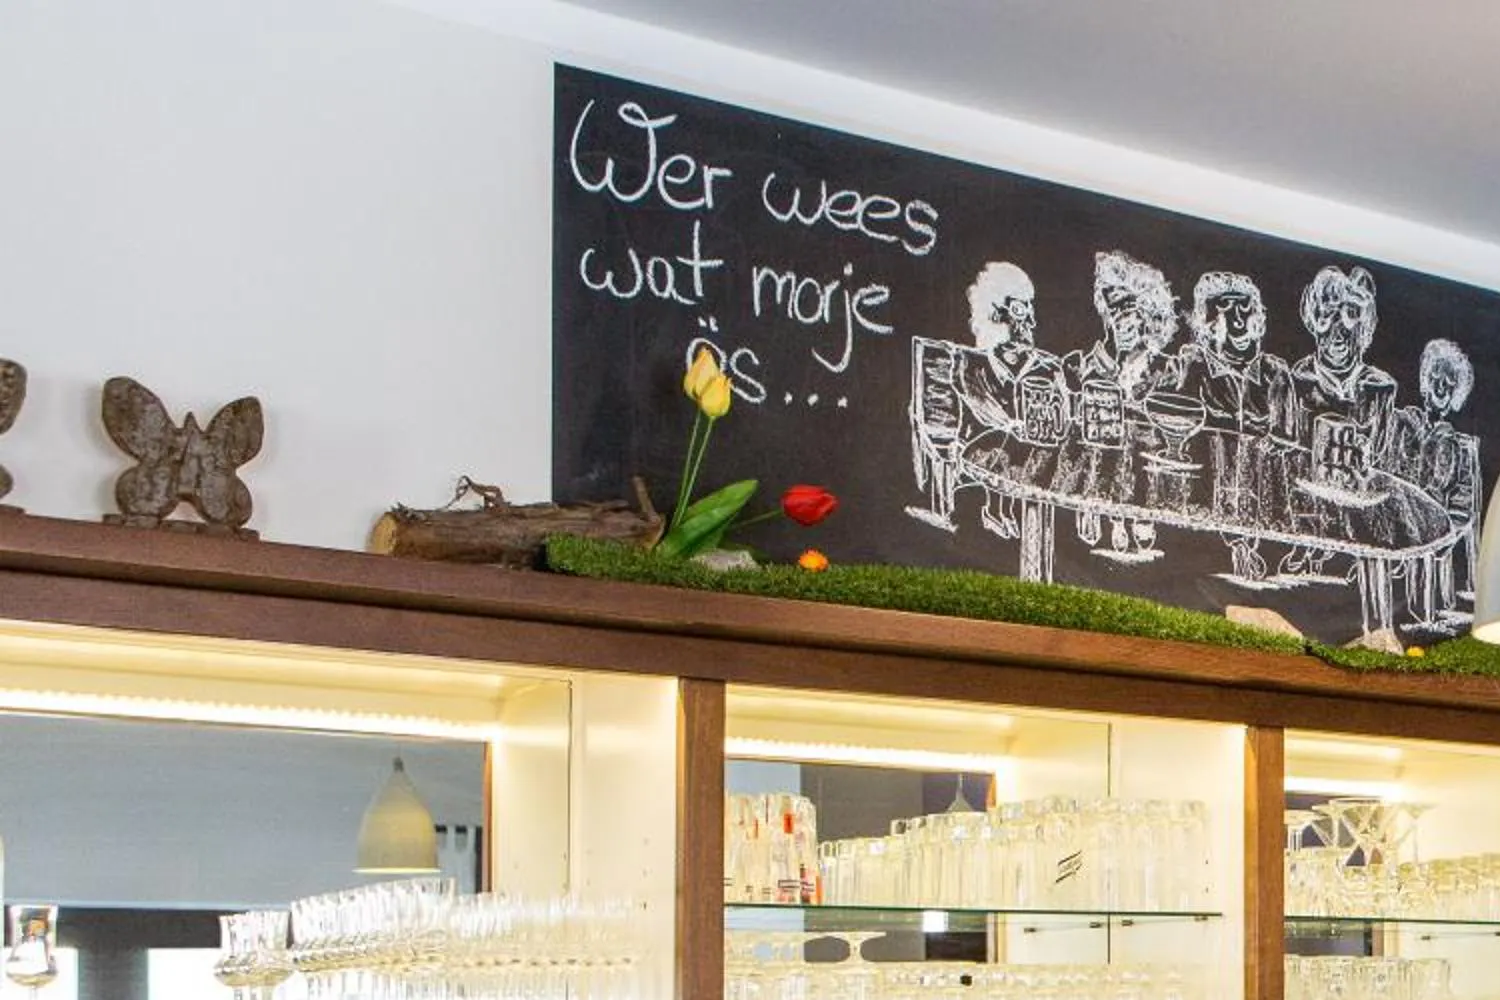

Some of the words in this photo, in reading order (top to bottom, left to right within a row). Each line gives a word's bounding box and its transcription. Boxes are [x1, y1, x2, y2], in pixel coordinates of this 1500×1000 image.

[570, 99, 733, 211] Wer
[762, 171, 940, 256] wees
[579, 220, 723, 306] wat
[752, 262, 894, 374] morje
